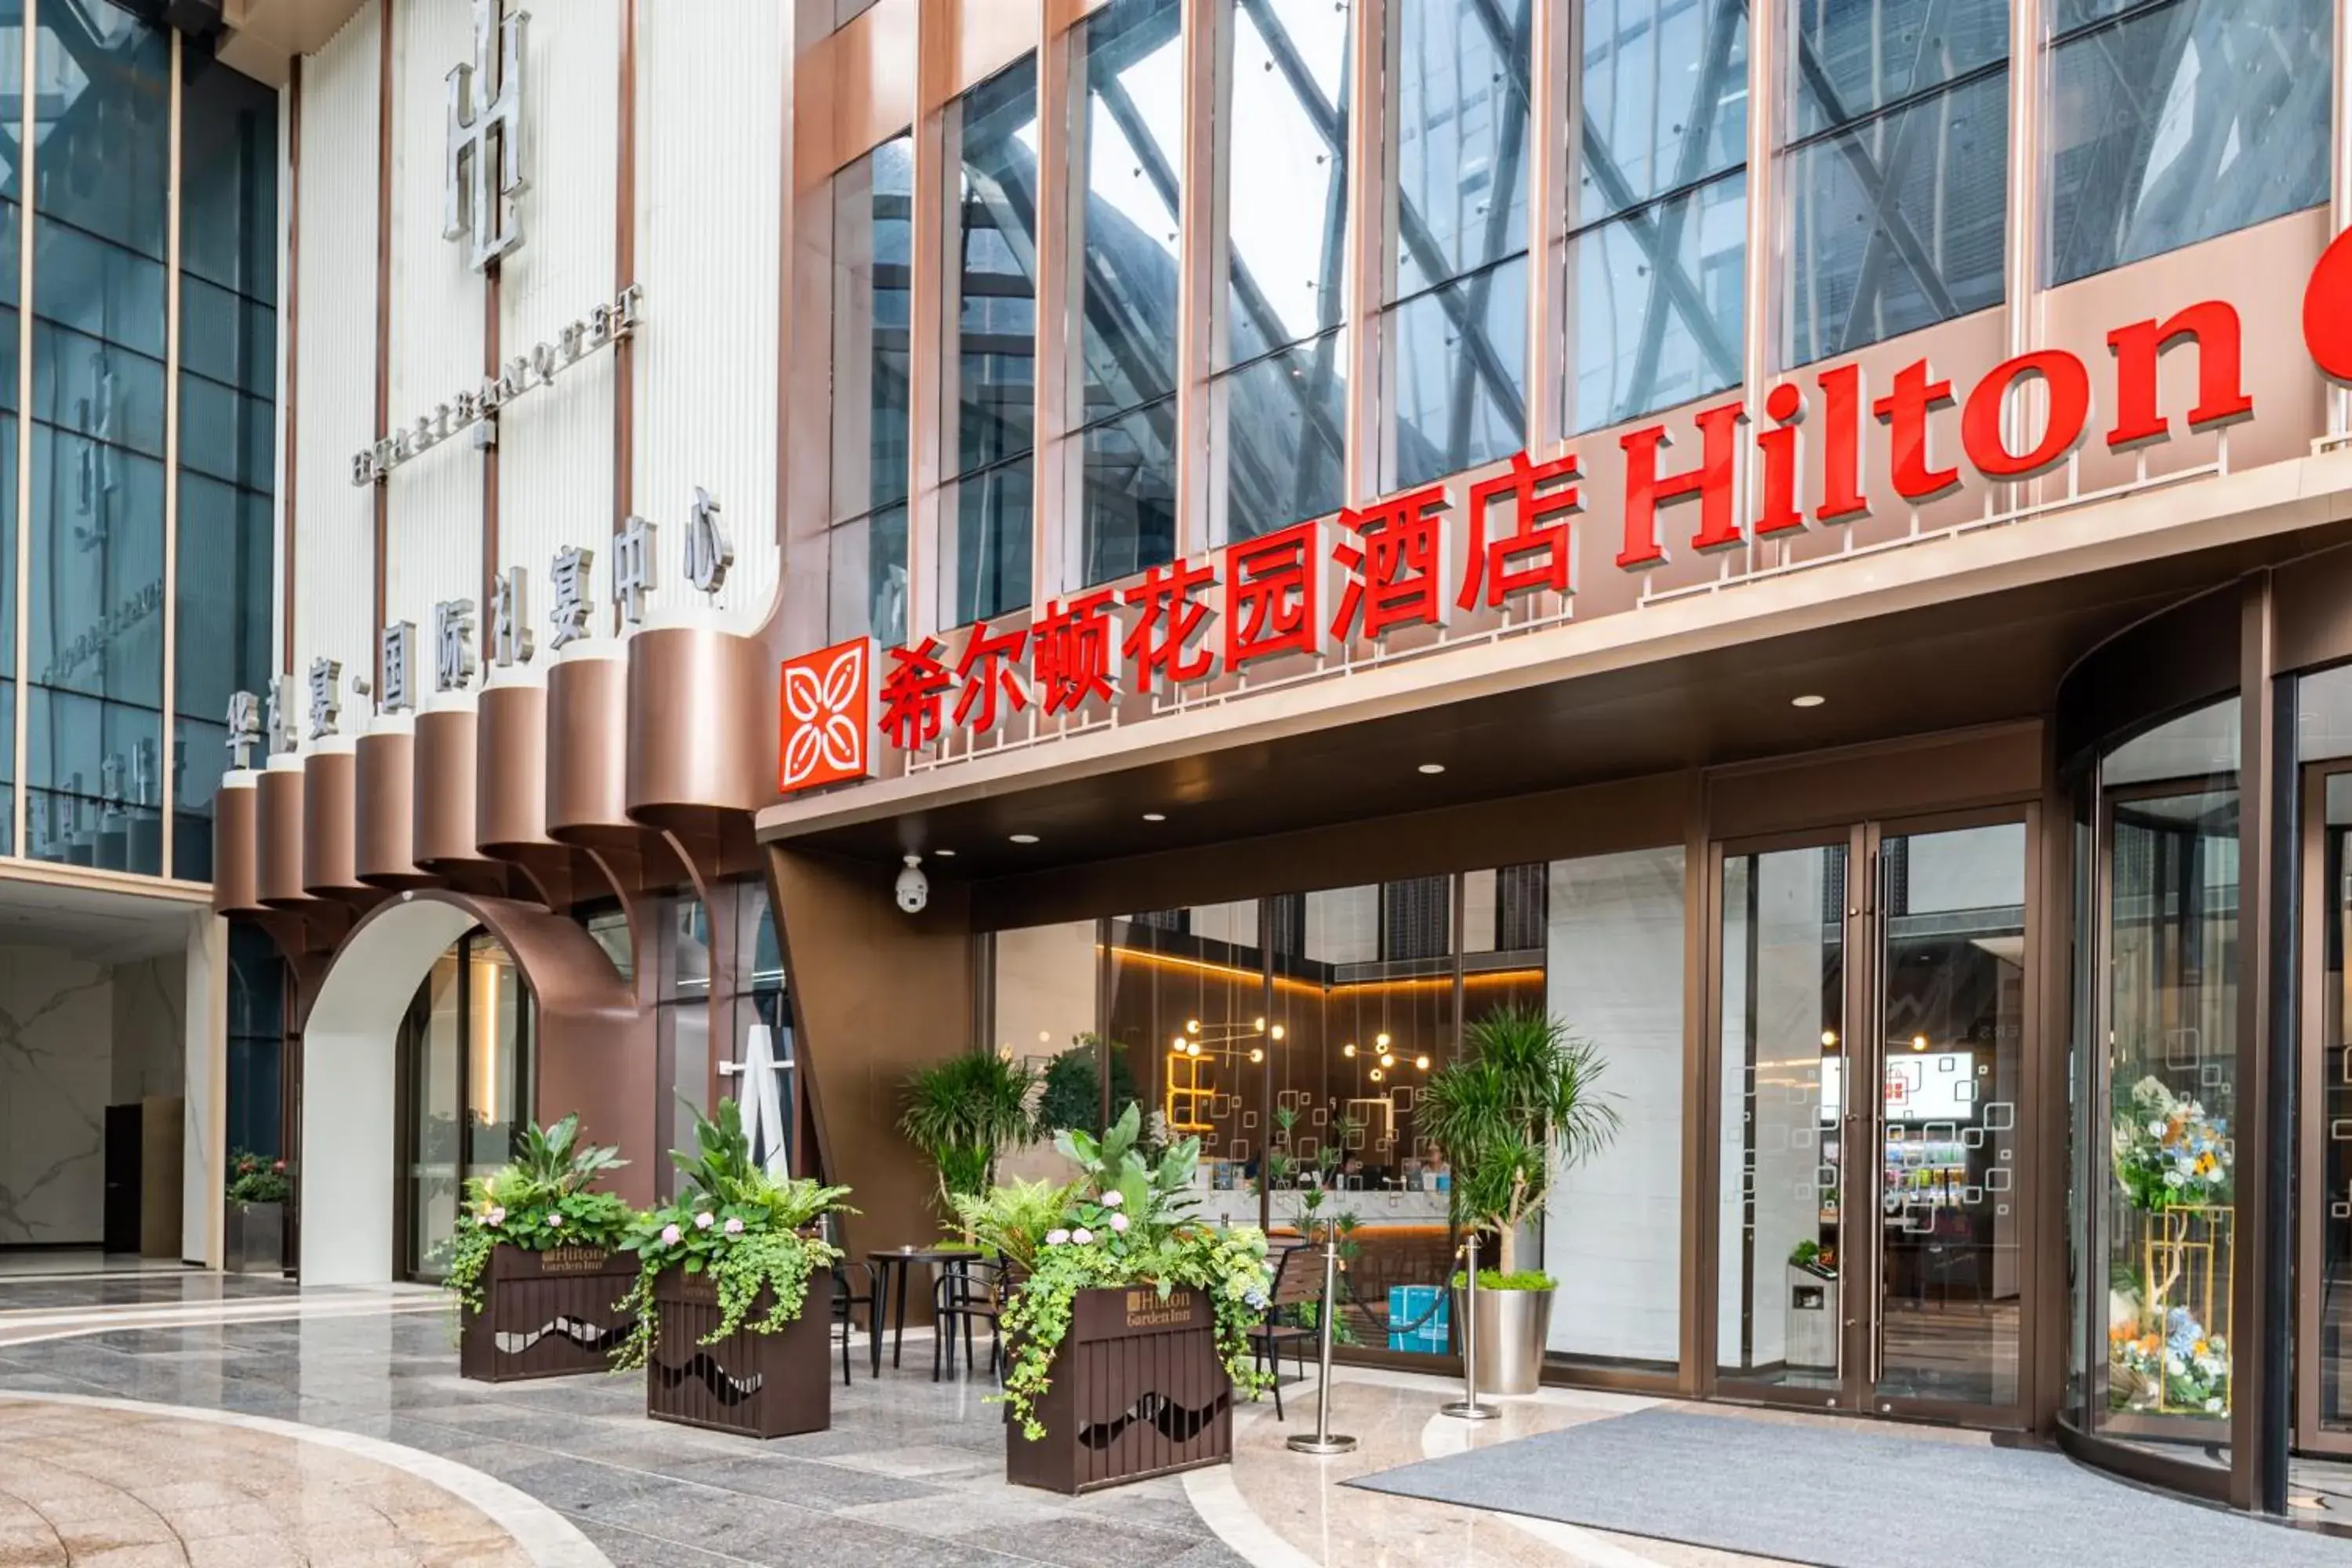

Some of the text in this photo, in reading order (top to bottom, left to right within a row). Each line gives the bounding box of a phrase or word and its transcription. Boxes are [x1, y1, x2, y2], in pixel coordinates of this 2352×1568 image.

[879, 451, 1582, 752] 希尔顿花园酒店
[1616, 299, 2253, 570] Hilton
[555, 1247, 602, 1261] Hilton
[1127, 1308, 1191, 1327] Garden Inn
